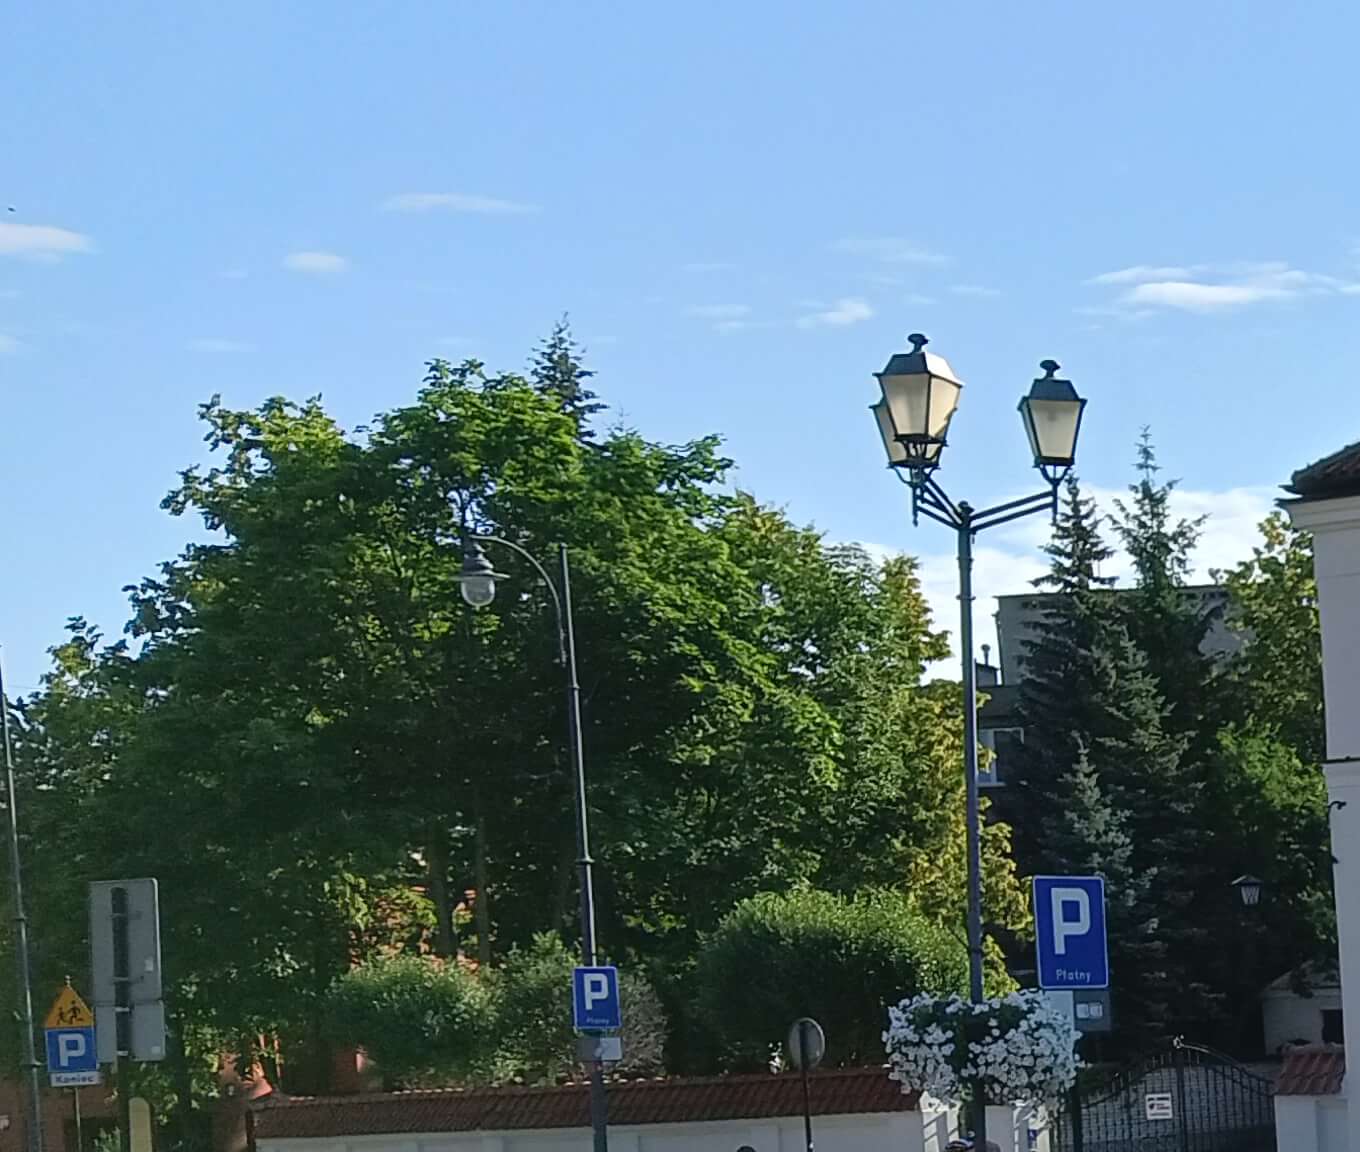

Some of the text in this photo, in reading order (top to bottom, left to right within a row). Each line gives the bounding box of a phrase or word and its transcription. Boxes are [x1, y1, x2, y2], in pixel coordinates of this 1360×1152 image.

[1051, 887, 1091, 955] P
[583, 973, 608, 1010] P
[59, 1033, 86, 1067] P
